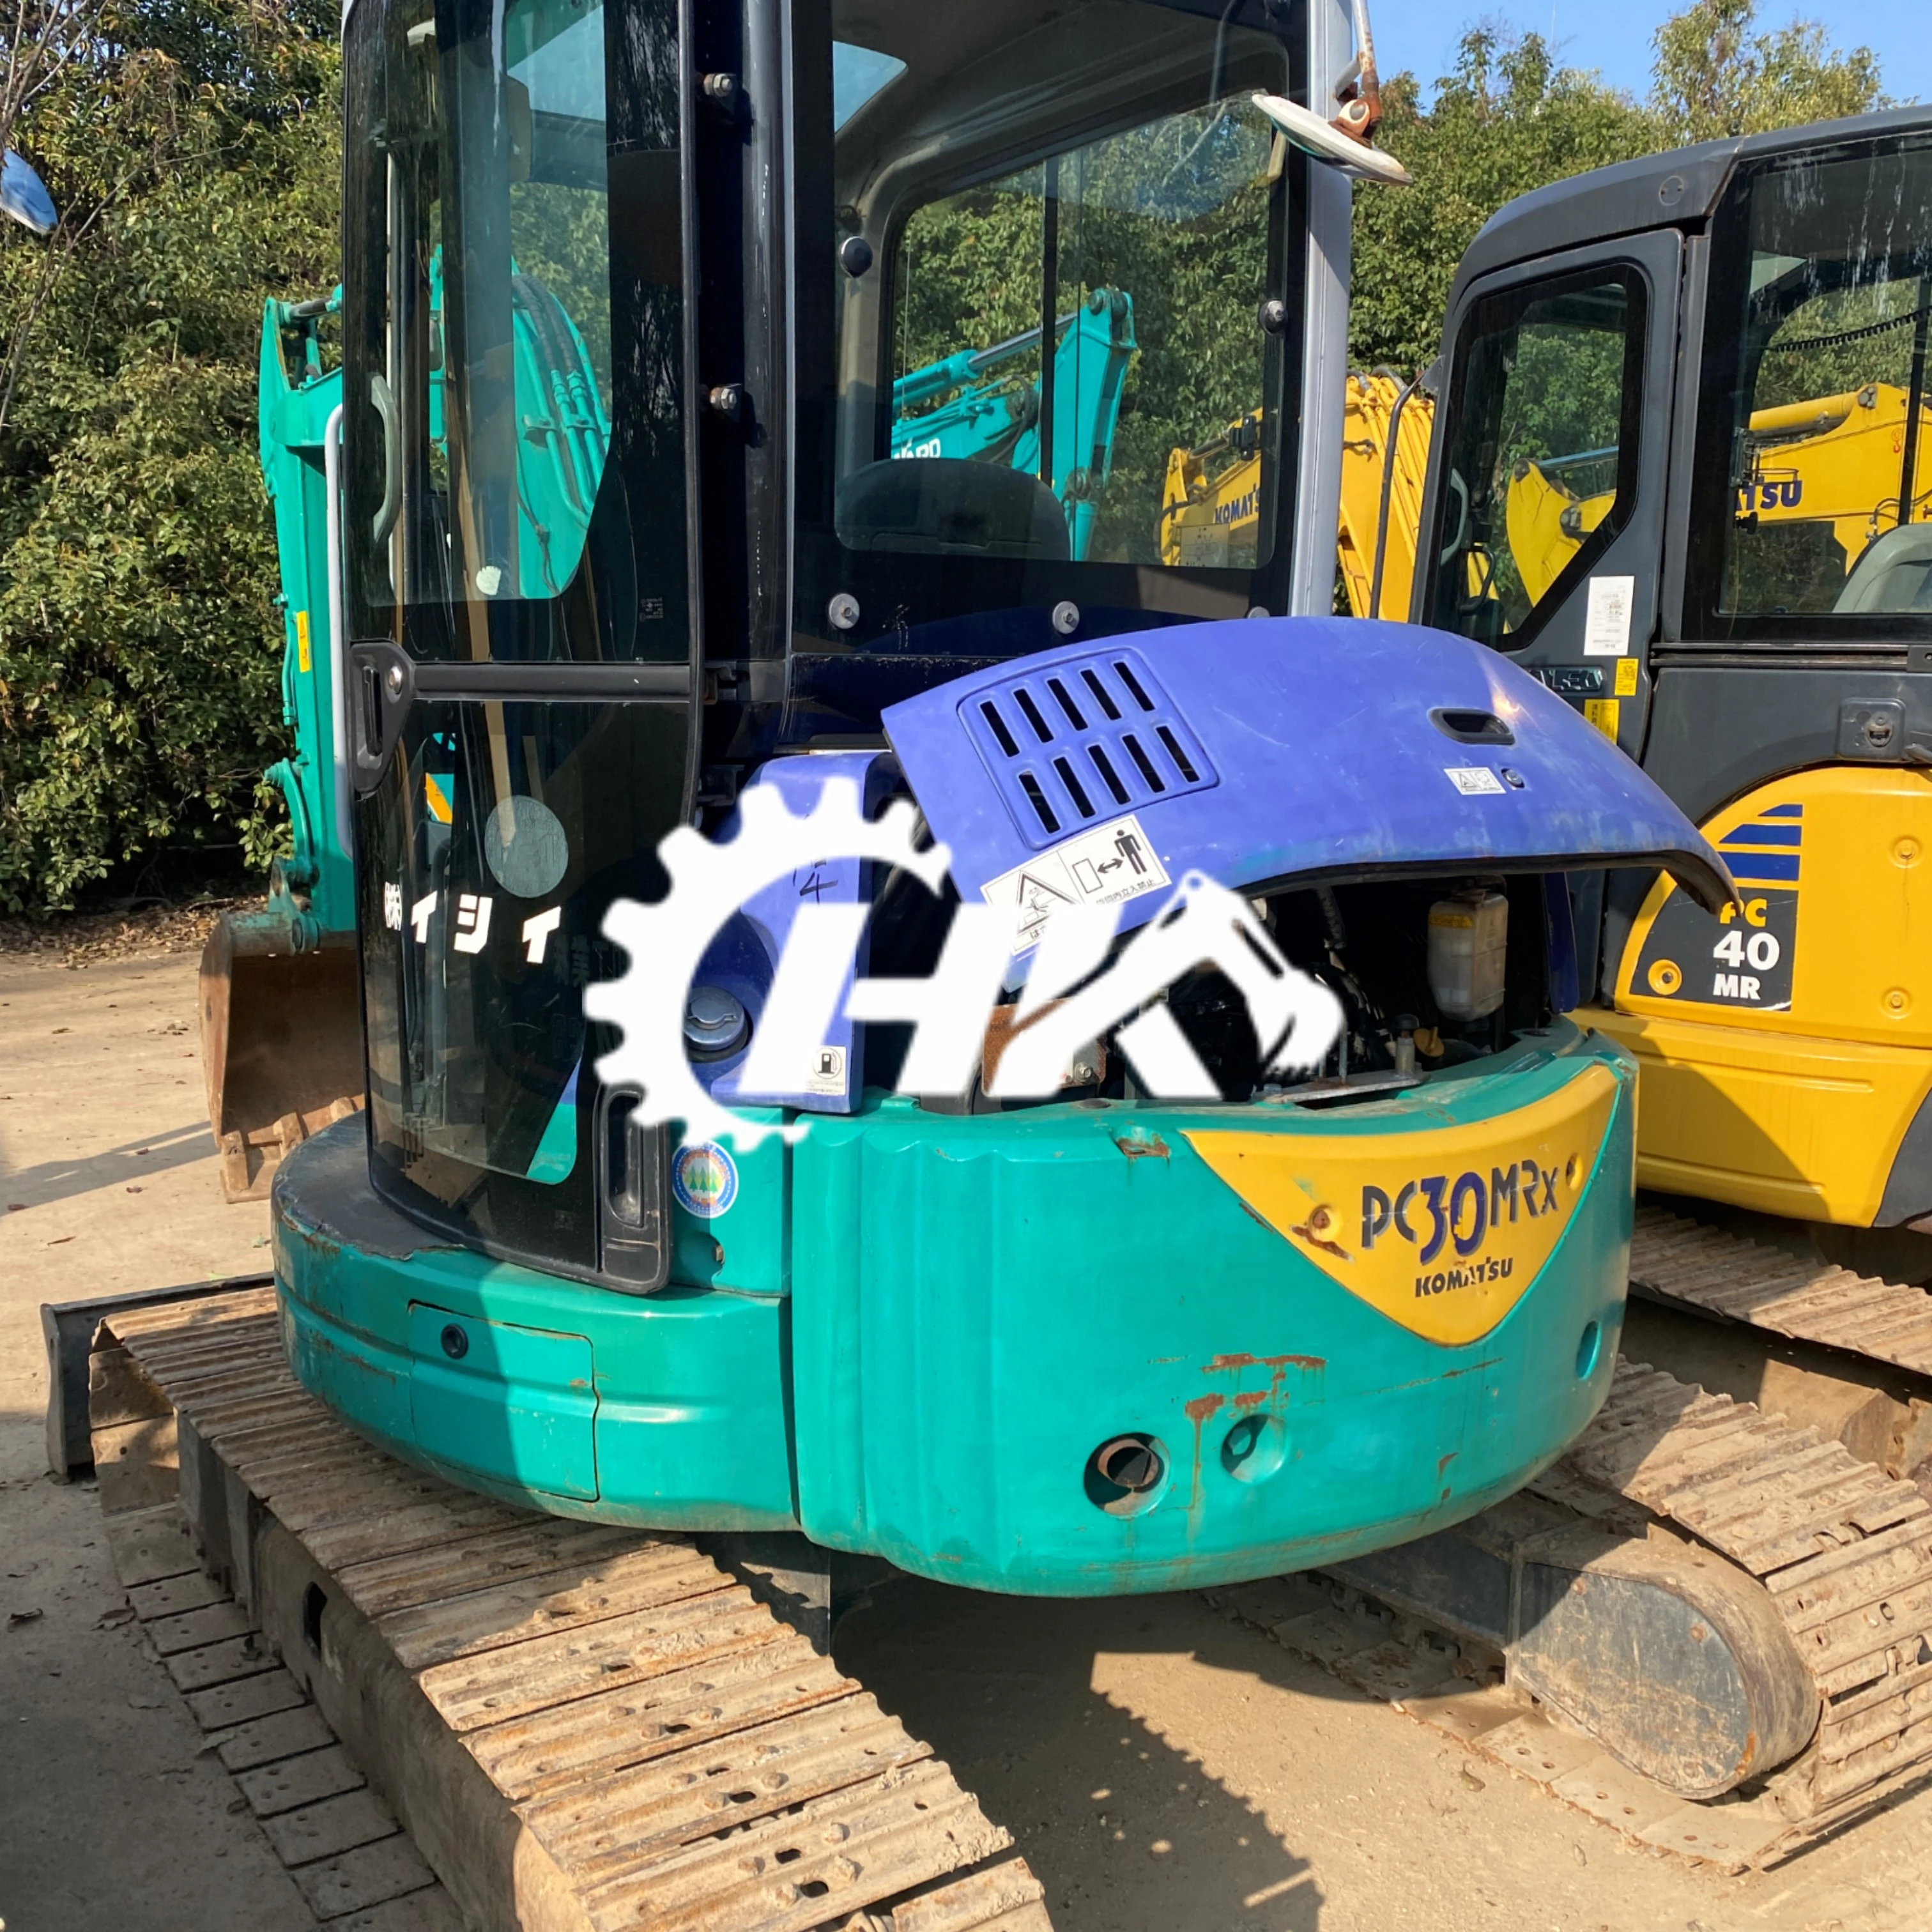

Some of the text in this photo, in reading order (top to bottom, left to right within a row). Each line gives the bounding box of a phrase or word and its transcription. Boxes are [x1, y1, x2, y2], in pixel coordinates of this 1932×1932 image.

[1713, 930, 1781, 970] 40
[1713, 973, 1761, 1000] MR
[1414, 1256, 1514, 1298] KOMATSU
